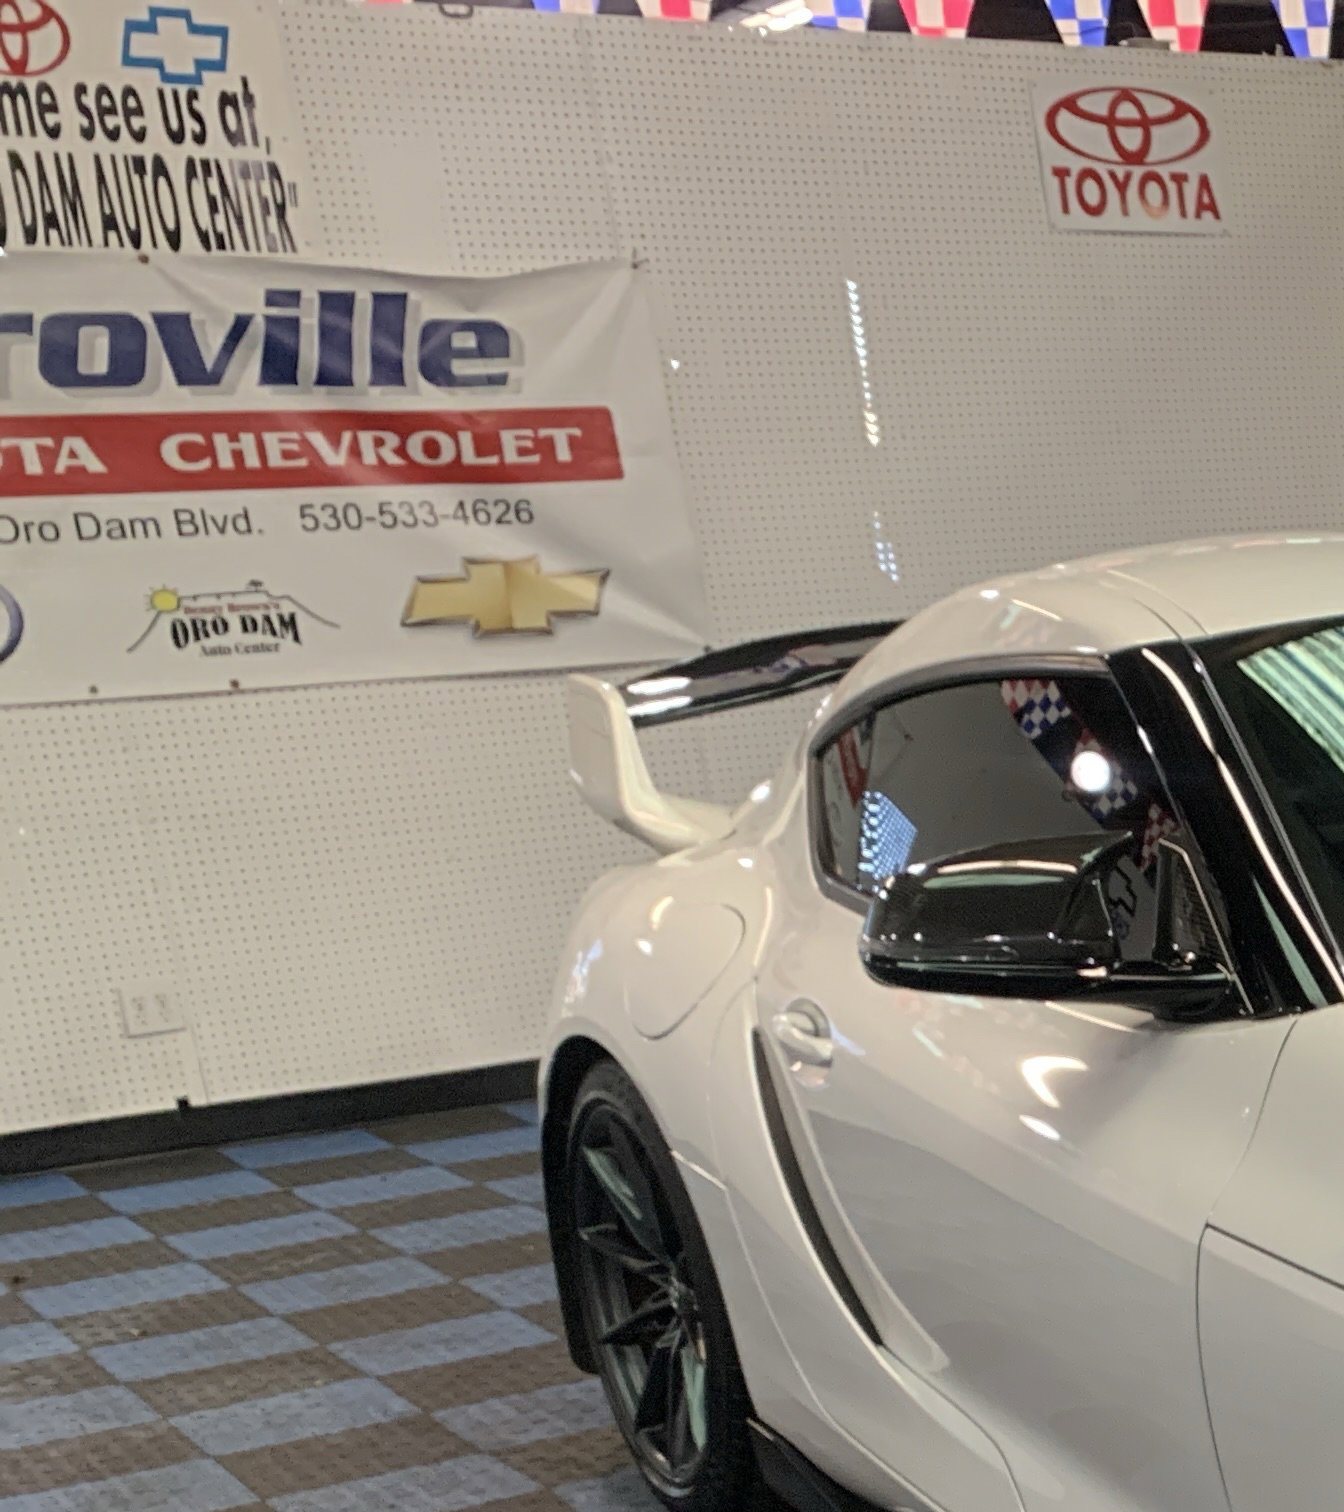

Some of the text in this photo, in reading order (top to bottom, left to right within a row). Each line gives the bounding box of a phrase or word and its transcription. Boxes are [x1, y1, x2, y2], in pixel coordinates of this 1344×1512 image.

[74, 82, 147, 144] see
[157, 87, 207, 145] us
[7, 149, 93, 247] DAM
[93, 152, 181, 251] AUTO
[1051, 166, 1222, 221] TOYOTA
[0, 426, 583, 476] TA CHEVROLET
[73, 511, 162, 541] Dam
[173, 506, 264, 537] Blvd.
[299, 498, 535, 534] 530-533-4626
[170, 612, 302, 650] ORO DAM
